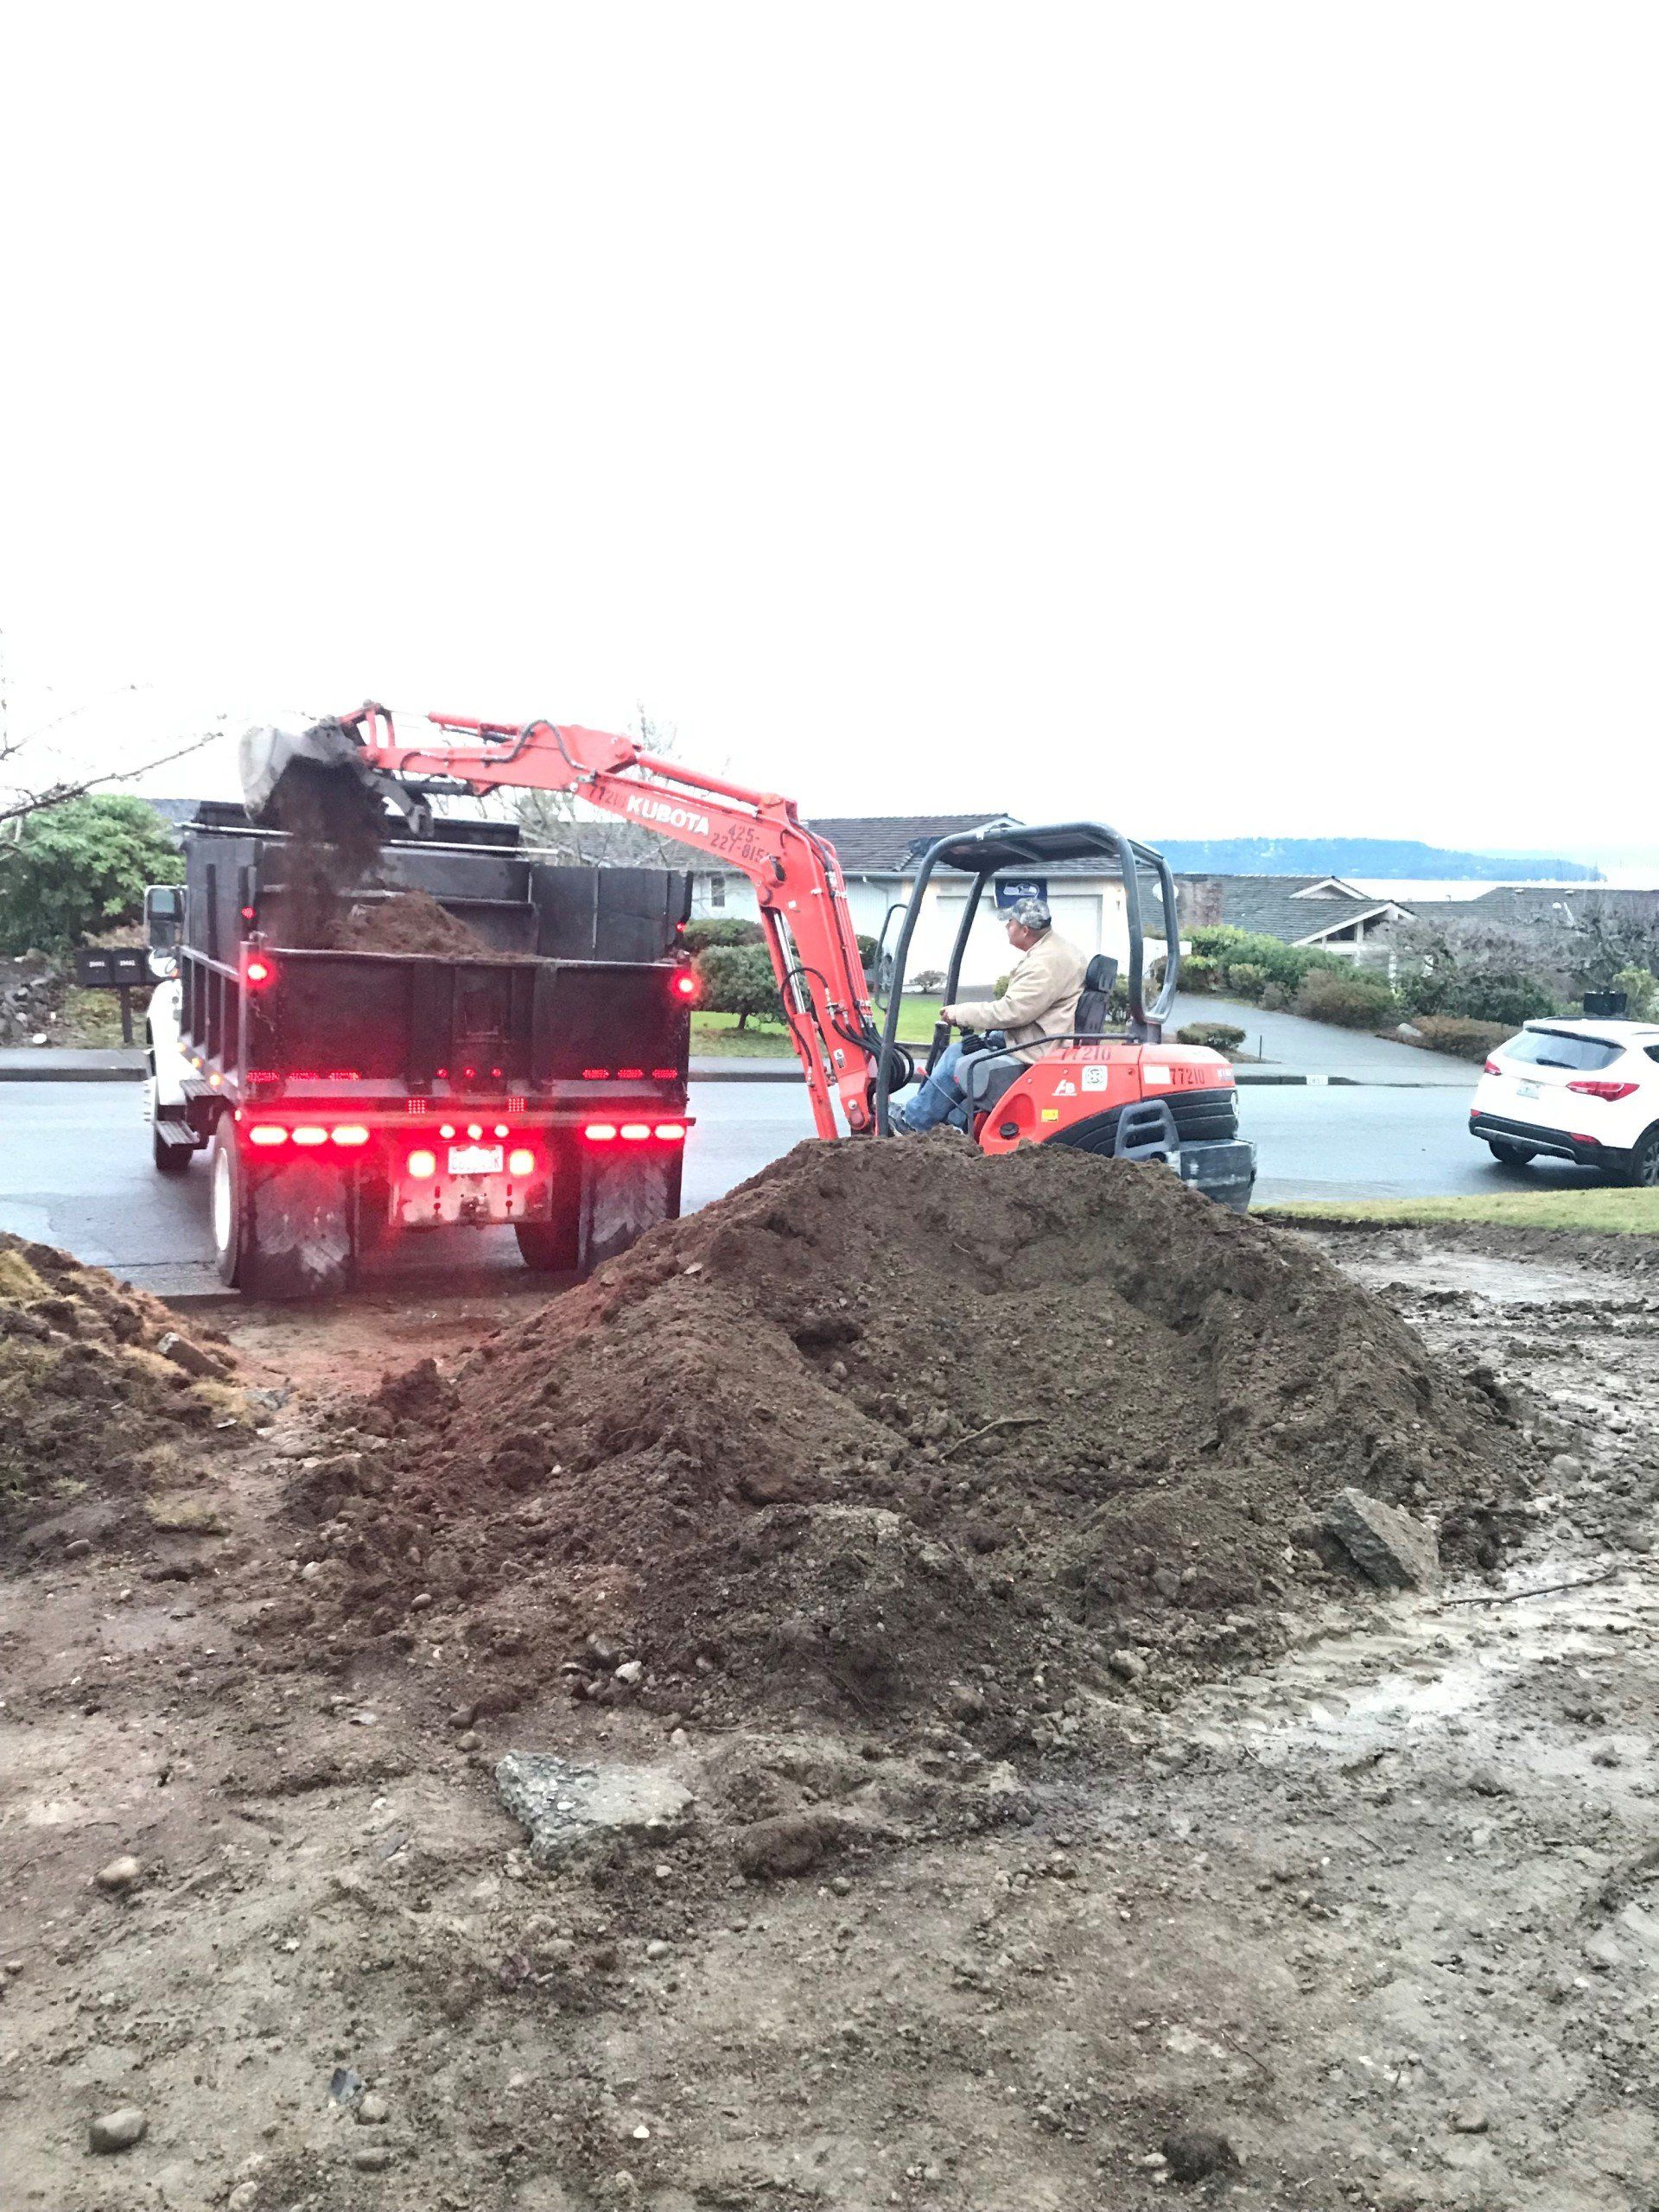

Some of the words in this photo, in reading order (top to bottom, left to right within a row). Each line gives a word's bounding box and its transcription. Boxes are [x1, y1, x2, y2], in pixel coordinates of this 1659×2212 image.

[626, 794, 709, 836] KUBOTA
[728, 823, 760, 843] 425-
[710, 832, 769, 862] 227-815
[1169, 1068, 1205, 1085] 77210
